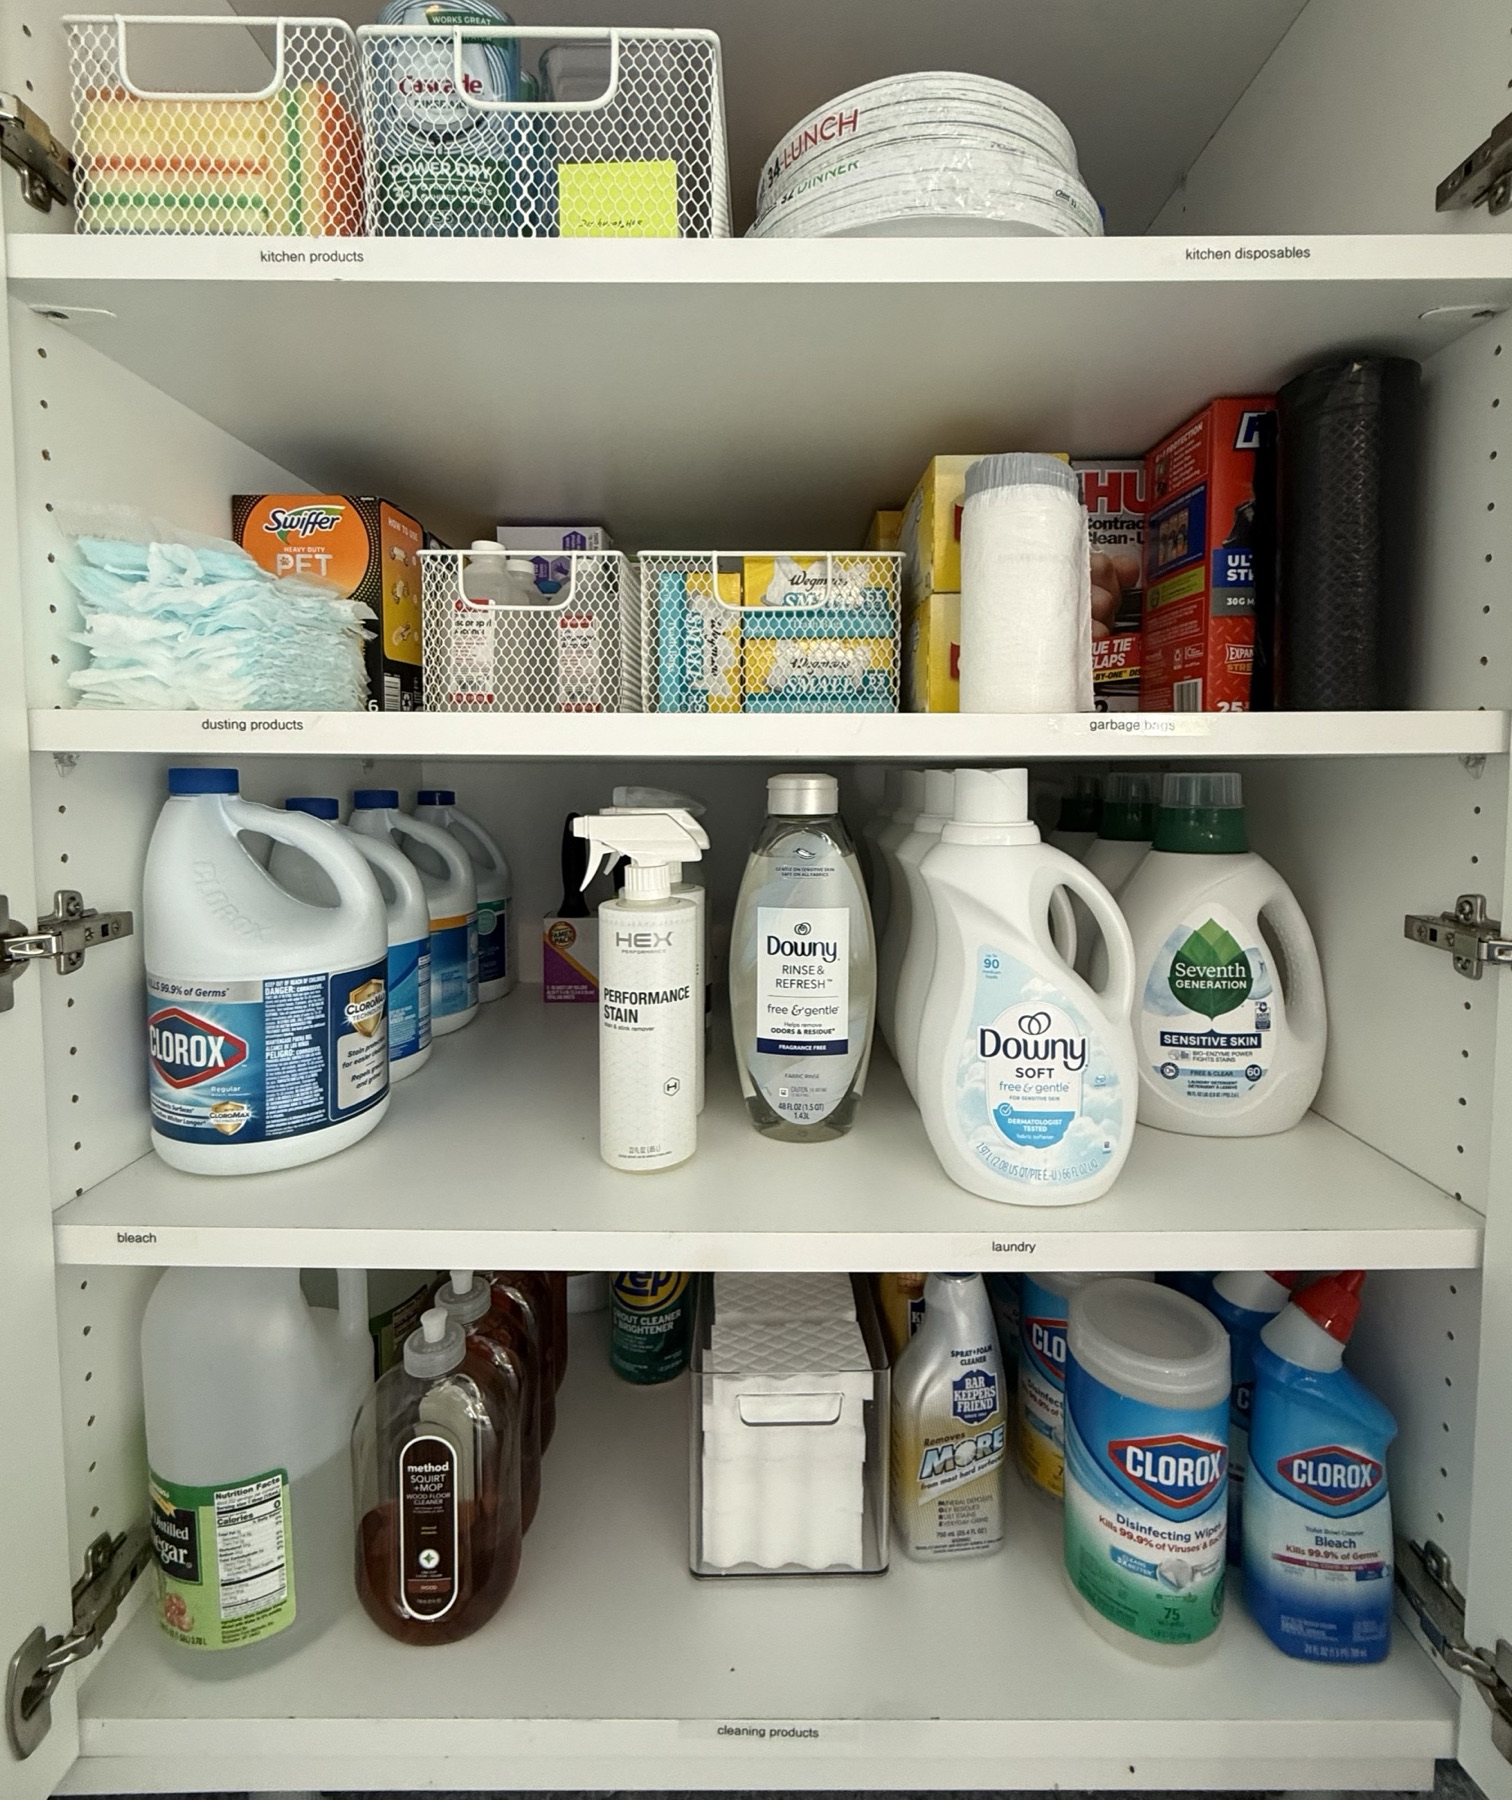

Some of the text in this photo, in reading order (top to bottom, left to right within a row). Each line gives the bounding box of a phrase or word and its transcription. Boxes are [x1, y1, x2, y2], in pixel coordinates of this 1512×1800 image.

[432, 16, 491, 25] WORKS GREAT
[782, 108, 858, 170] LUNCH
[391, 161, 492, 180] POWER DRY
[260, 249, 364, 265] kitchen products
[1185, 246, 1311, 262] kitchen disposables
[264, 509, 342, 538] Swiffer
[388, 516, 418, 542] HOW TO USE
[284, 546, 325, 554] HEAVY DUTY
[277, 553, 333, 577] PET
[1113, 638, 1132, 653] TIE
[368, 700, 379, 711] 6
[202, 718, 303, 732] dusting products
[1090, 717, 1175, 732] garbage bags
[616, 932, 673, 947] HEX
[767, 935, 837, 963] Downy
[782, 965, 825, 975] RINSE &
[984, 959, 1000, 969] 90
[1175, 962, 1246, 978] Seventh
[161, 983, 226, 998] 99.9% of Germs
[1175, 980, 1247, 990] GENERATION
[603, 985, 690, 1005] PERFORMANCE
[603, 1004, 638, 1024] STAIN
[767, 1004, 837, 1017] free & gentle
[149, 1025, 225, 1068] CLOROX
[1163, 1035, 1258, 1047] SENSITIVE SKIN
[347, 1045, 364, 1058] Stain
[980, 1028, 1086, 1071] Downy
[342, 1060, 353, 1069] for
[1246, 1067, 1260, 1076] 60
[1015, 1068, 1055, 1079] SOFT
[211, 1086, 241, 1094] Regular
[356, 1079, 368, 1089] and
[999, 1081, 1069, 1094] free & gentle
[787, 1103, 794, 1111] FL
[795, 1103, 802, 1111] OZ
[802, 1103, 814, 1111] (1.5
[1007, 1118, 1063, 1126] DERMATOLOGIST
[117, 1232, 157, 1243] bleach
[992, 1241, 1036, 1253] laundry
[640, 1308, 682, 1326] CLEANER
[618, 1321, 674, 1335] BRIGHTENER
[960, 1355, 987, 1366] CLEANER
[965, 1376, 985, 1389] BAR
[953, 1385, 996, 1402] KEEPERS
[957, 1399, 993, 1413] FRIEND
[924, 1432, 965, 1447] Removes
[919, 1424, 1005, 1481] MORE
[407, 1462, 449, 1473] method
[1126, 1445, 1221, 1487] CLOROX
[1292, 1458, 1372, 1488] CLOROX
[410, 1474, 446, 1485] SQUIRT
[921, 1480, 939, 1491] from
[940, 1475, 958, 1486] most
[959, 1467, 976, 1480] hard
[215, 1476, 280, 1500] Nutrition Facts
[414, 1484, 443, 1493] +MOP
[274, 1499, 281, 1509] 0
[413, 1498, 443, 1506] CLEANER
[216, 1512, 253, 1526] Calories
[1098, 1515, 1118, 1533] Kills
[1119, 1528, 1154, 1548] 99.9%
[1155, 1542, 1166, 1550] of
[1167, 1544, 1200, 1553] Viruses
[1116, 1513, 1191, 1543] Disinfecting
[1315, 1536, 1356, 1549] Bleach
[1286, 1544, 1305, 1555] Kills
[1307, 1548, 1339, 1560] 99.9%
[1352, 1551, 1378, 1560] Germs
[1164, 1607, 1180, 1620] 75
[717, 1725, 819, 1738] cleaning products
